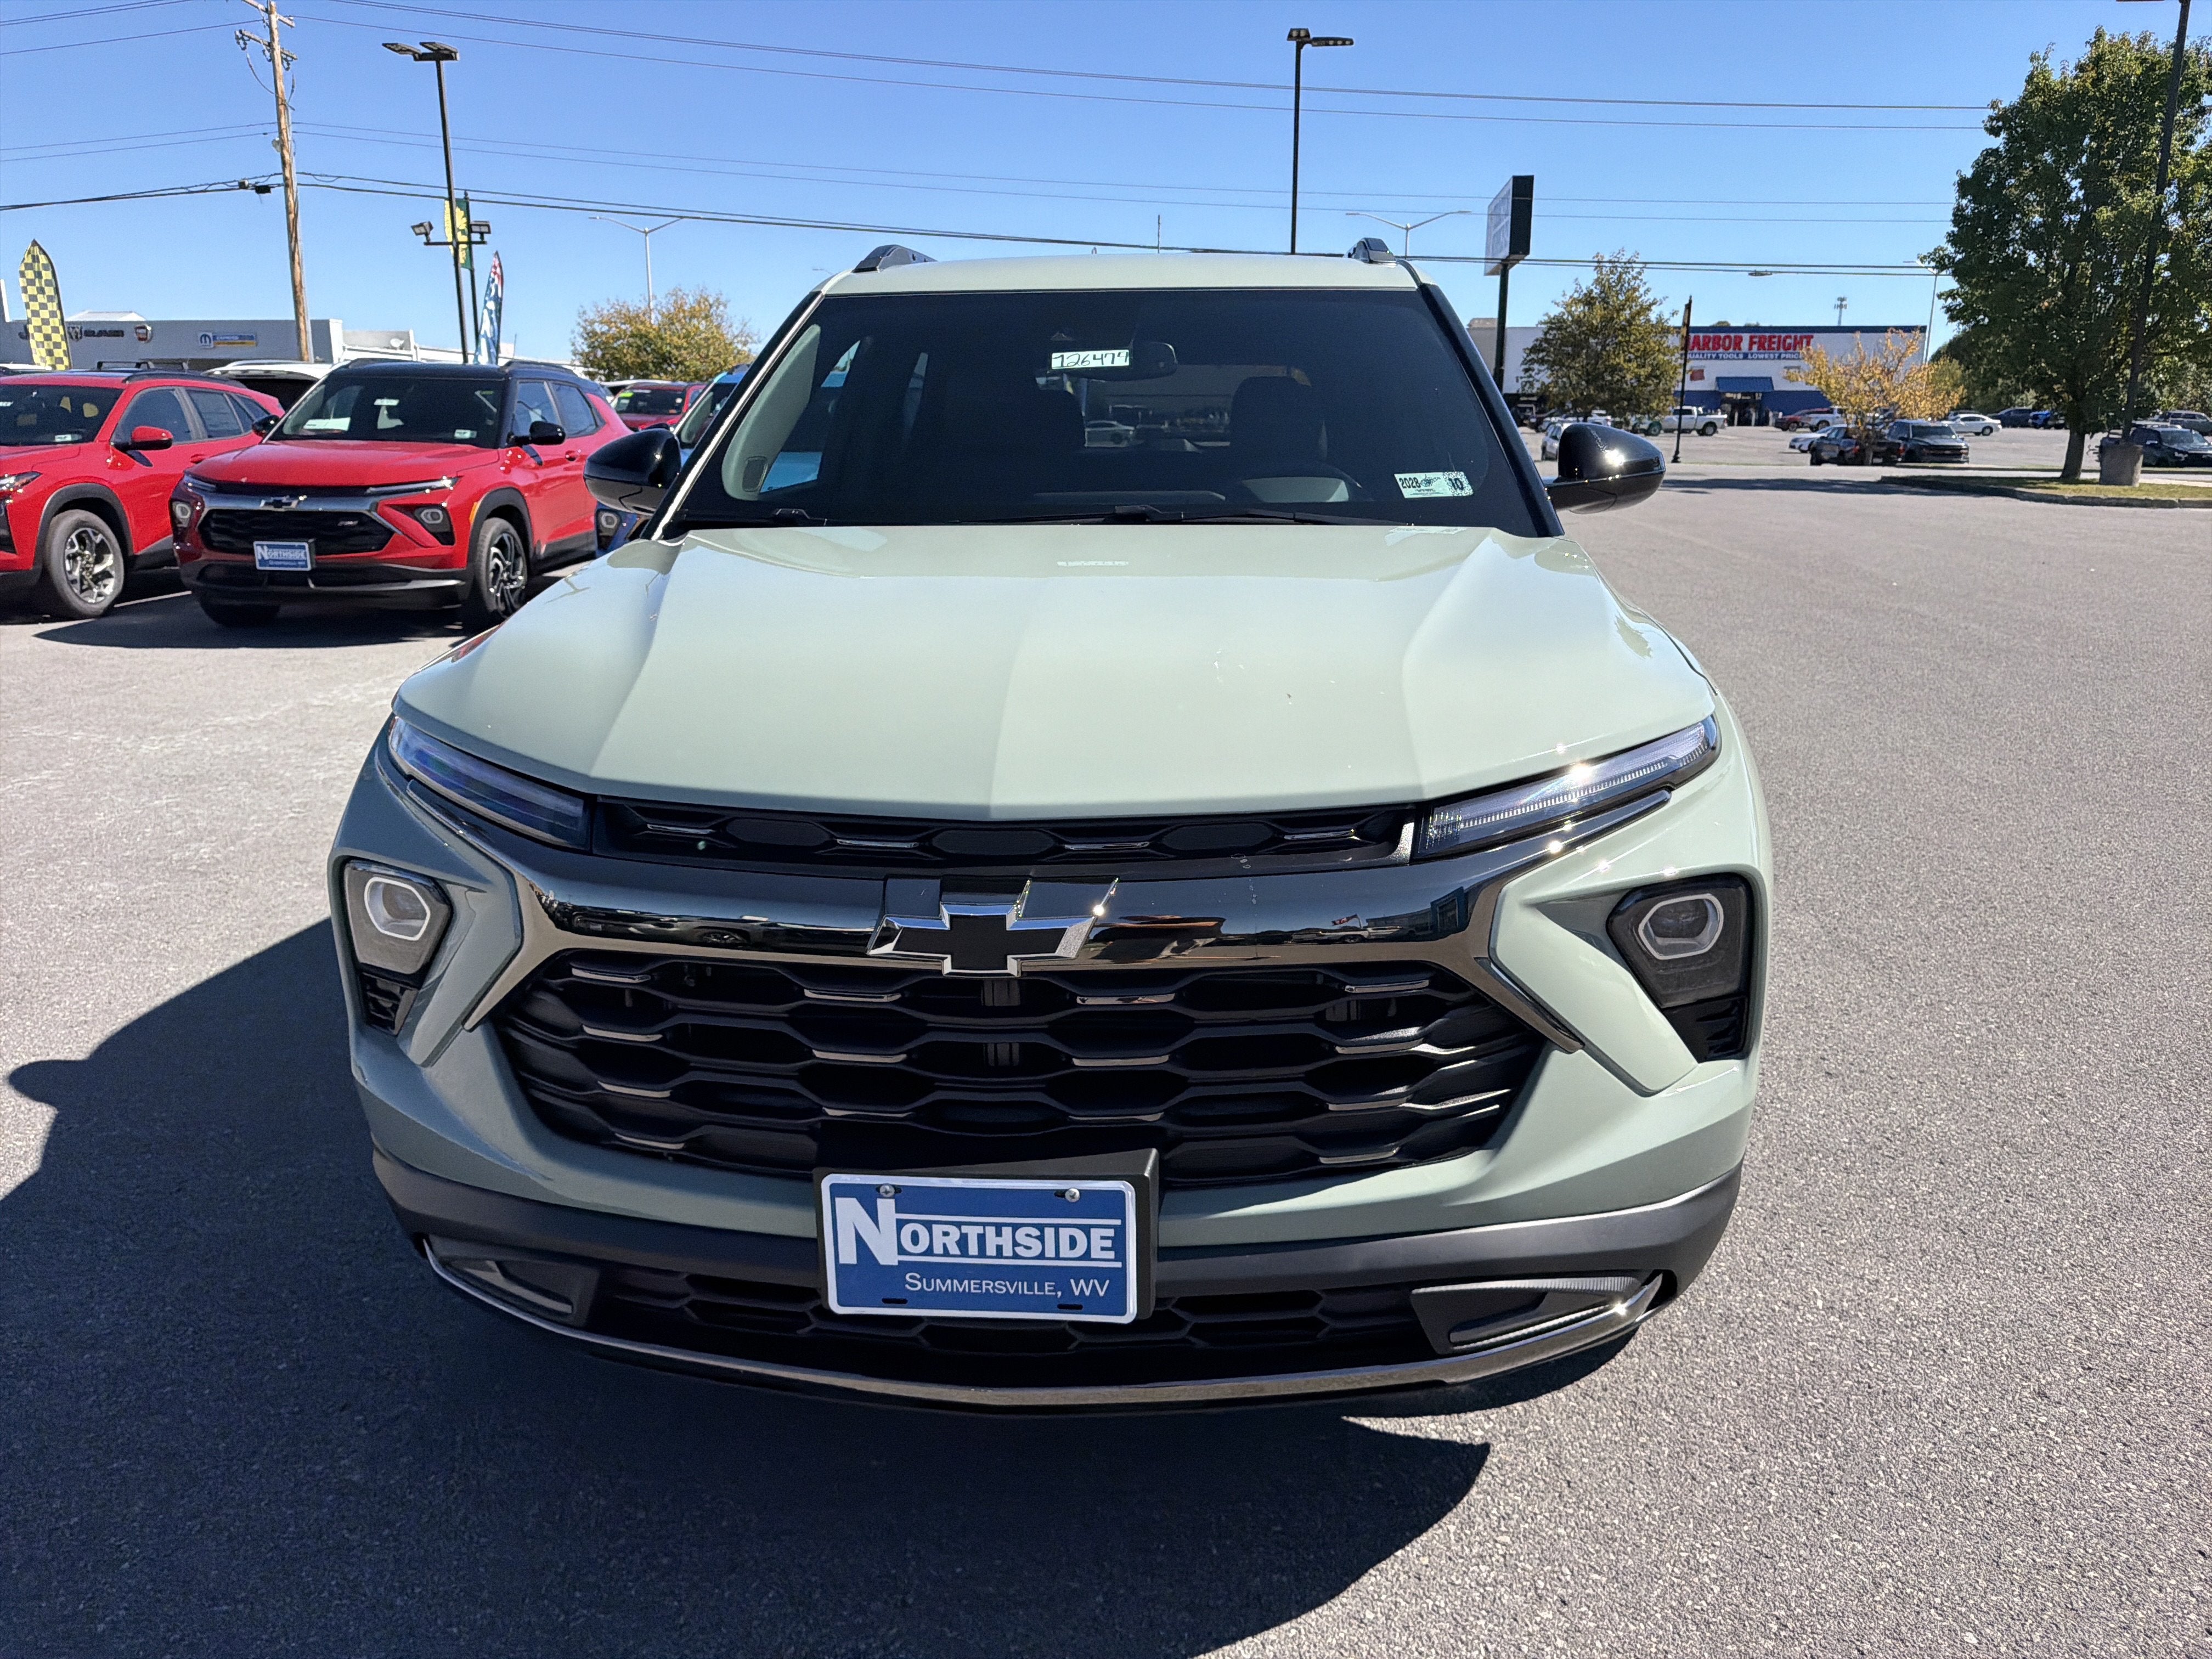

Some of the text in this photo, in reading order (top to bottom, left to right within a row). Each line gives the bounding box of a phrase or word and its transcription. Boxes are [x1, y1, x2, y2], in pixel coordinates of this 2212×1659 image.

[1688, 335, 1814, 351] ARBOR FREIGHT
[1399, 477, 1464, 490] 2028 10
[834, 1197, 1115, 1266] NORTHSIDE
[904, 1272, 1110, 1298] SUMMERSVILLE, WV
